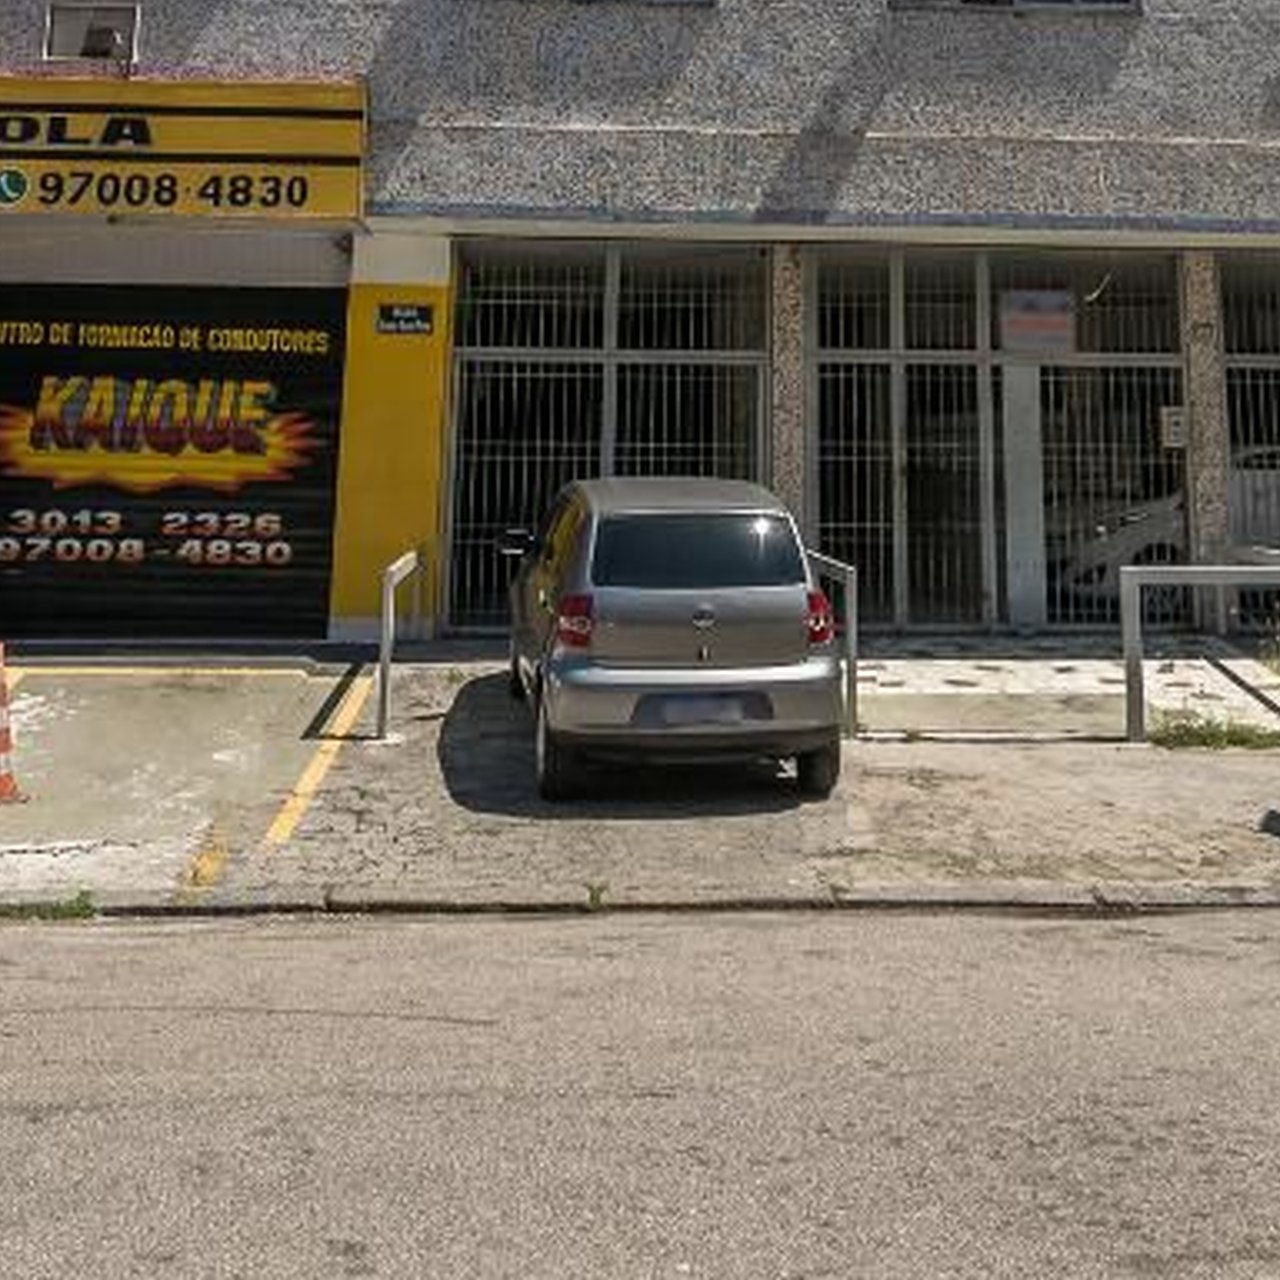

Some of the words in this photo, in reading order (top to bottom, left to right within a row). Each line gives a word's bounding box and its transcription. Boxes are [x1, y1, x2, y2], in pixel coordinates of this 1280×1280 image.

[48, 322, 72, 346] DE
[179, 326, 202, 351] DE
[207, 328, 330, 355] CONDUTORES
[30, 376, 274, 455] KAIQUE
[8, 509, 122, 534] 3013
[161, 512, 283, 537] 2326
